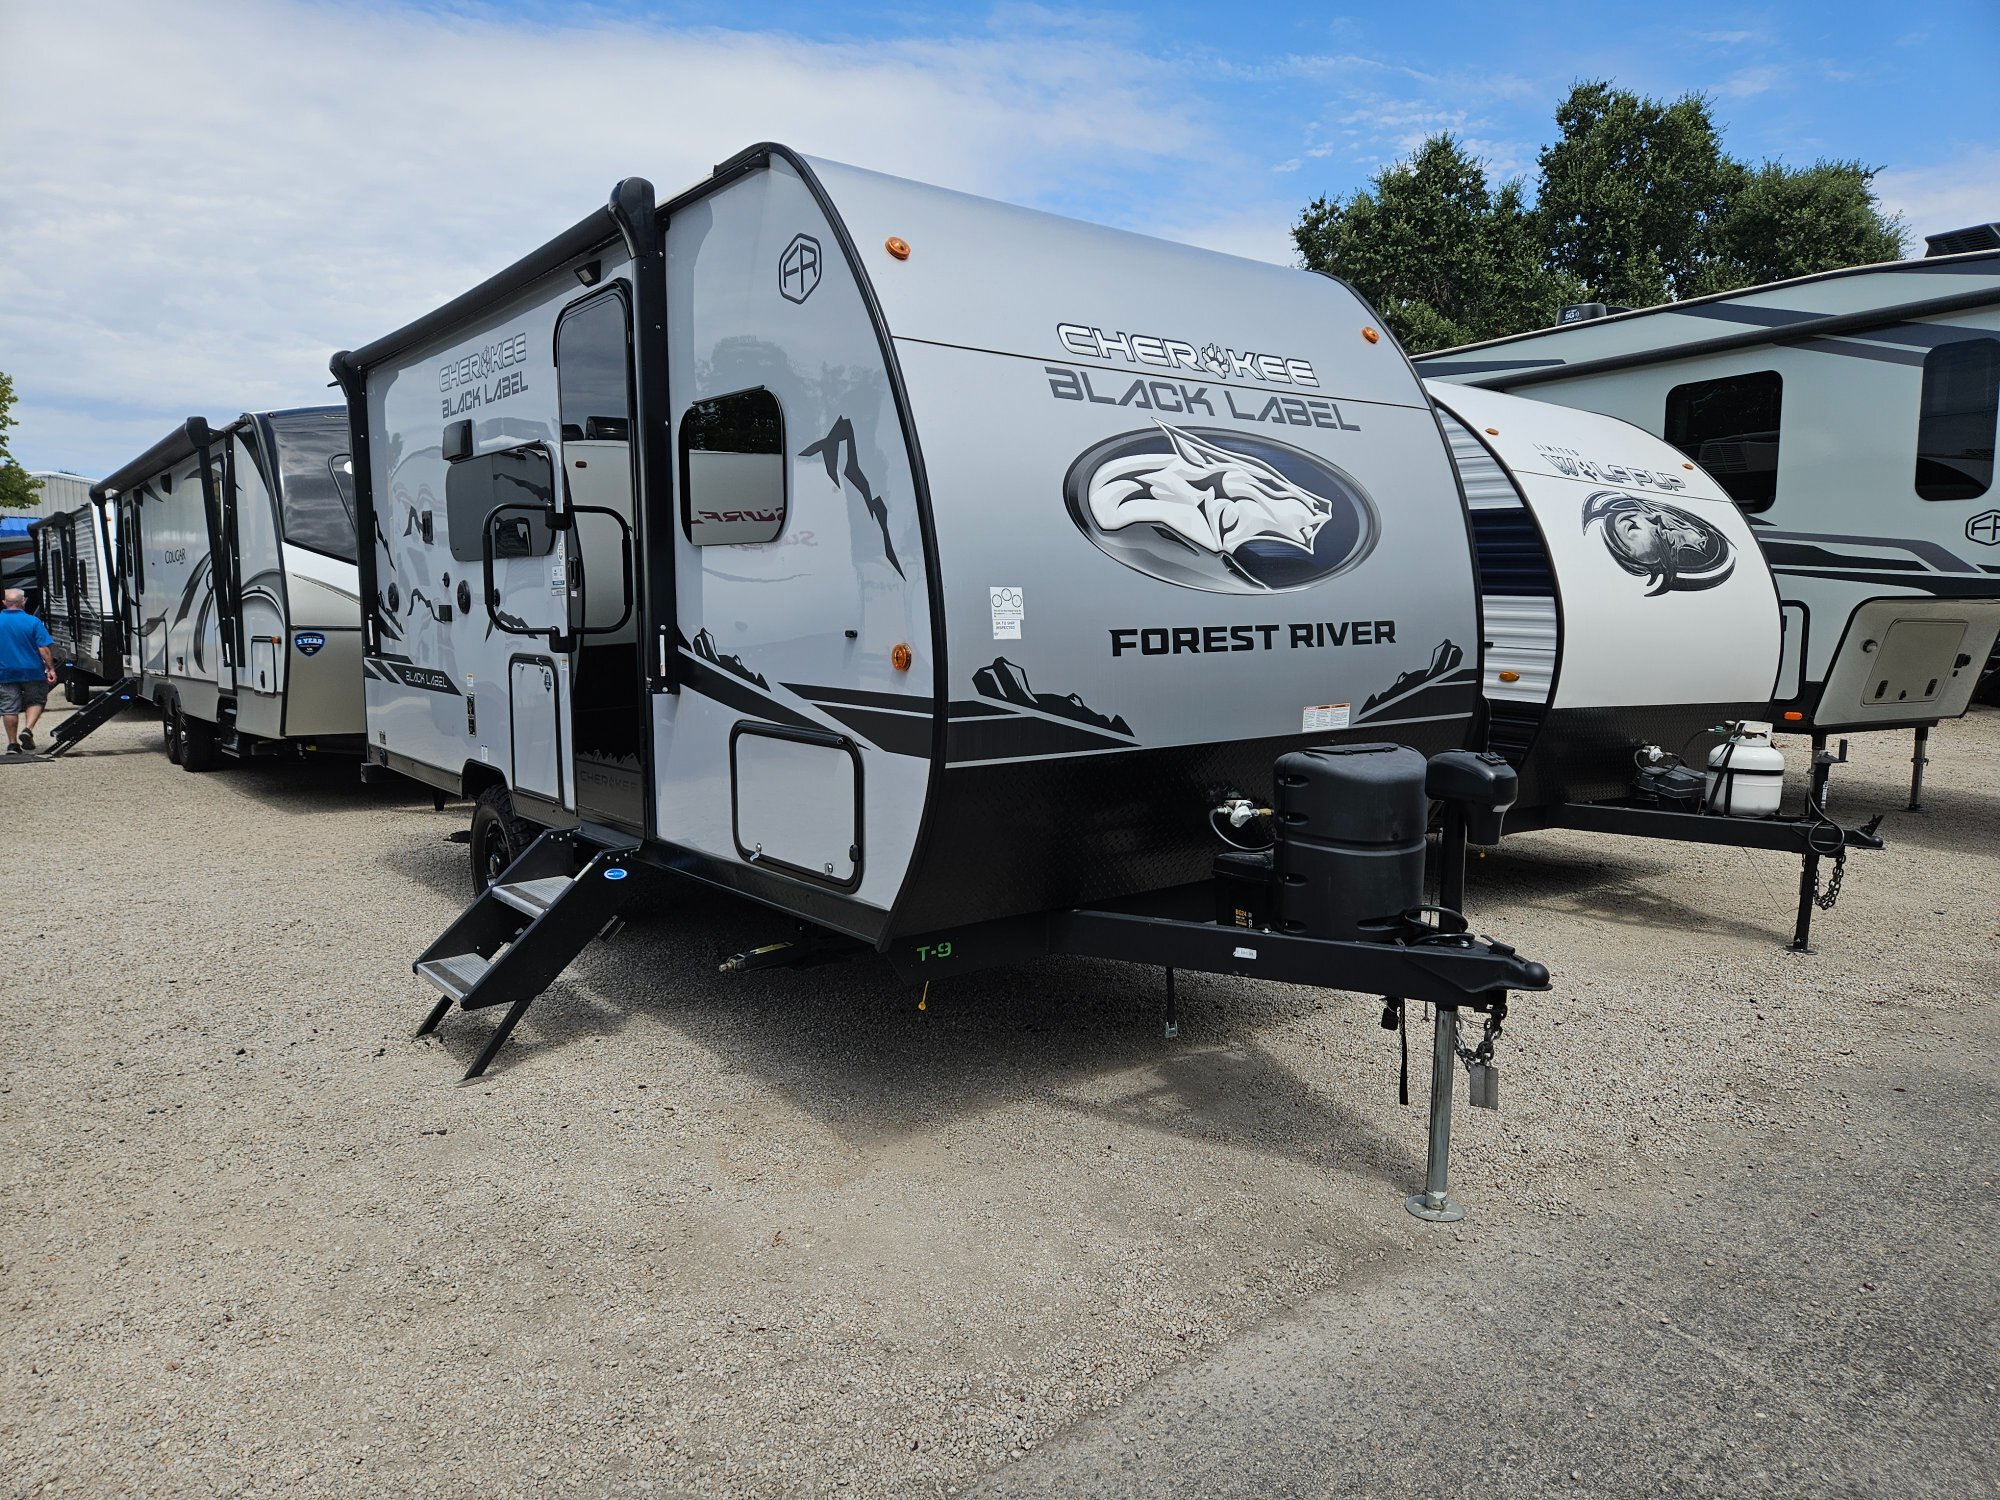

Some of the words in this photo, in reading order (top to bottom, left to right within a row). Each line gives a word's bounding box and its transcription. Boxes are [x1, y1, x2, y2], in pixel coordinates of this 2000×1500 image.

[442, 386, 481, 419] BLACK
[485, 370, 529, 404] LABEL
[1045, 366, 1216, 417] BLACK
[1224, 390, 1362, 432] LABEL
[1532, 443, 1580, 456] LIMITED
[302, 637, 323, 645] YEAR
[1108, 627, 1280, 657] FOREST
[1287, 620, 1397, 649] RIVER
[405, 670, 425, 684] BLACK
[425, 673, 448, 688] LABEL
[916, 942, 952, 961] T-9
